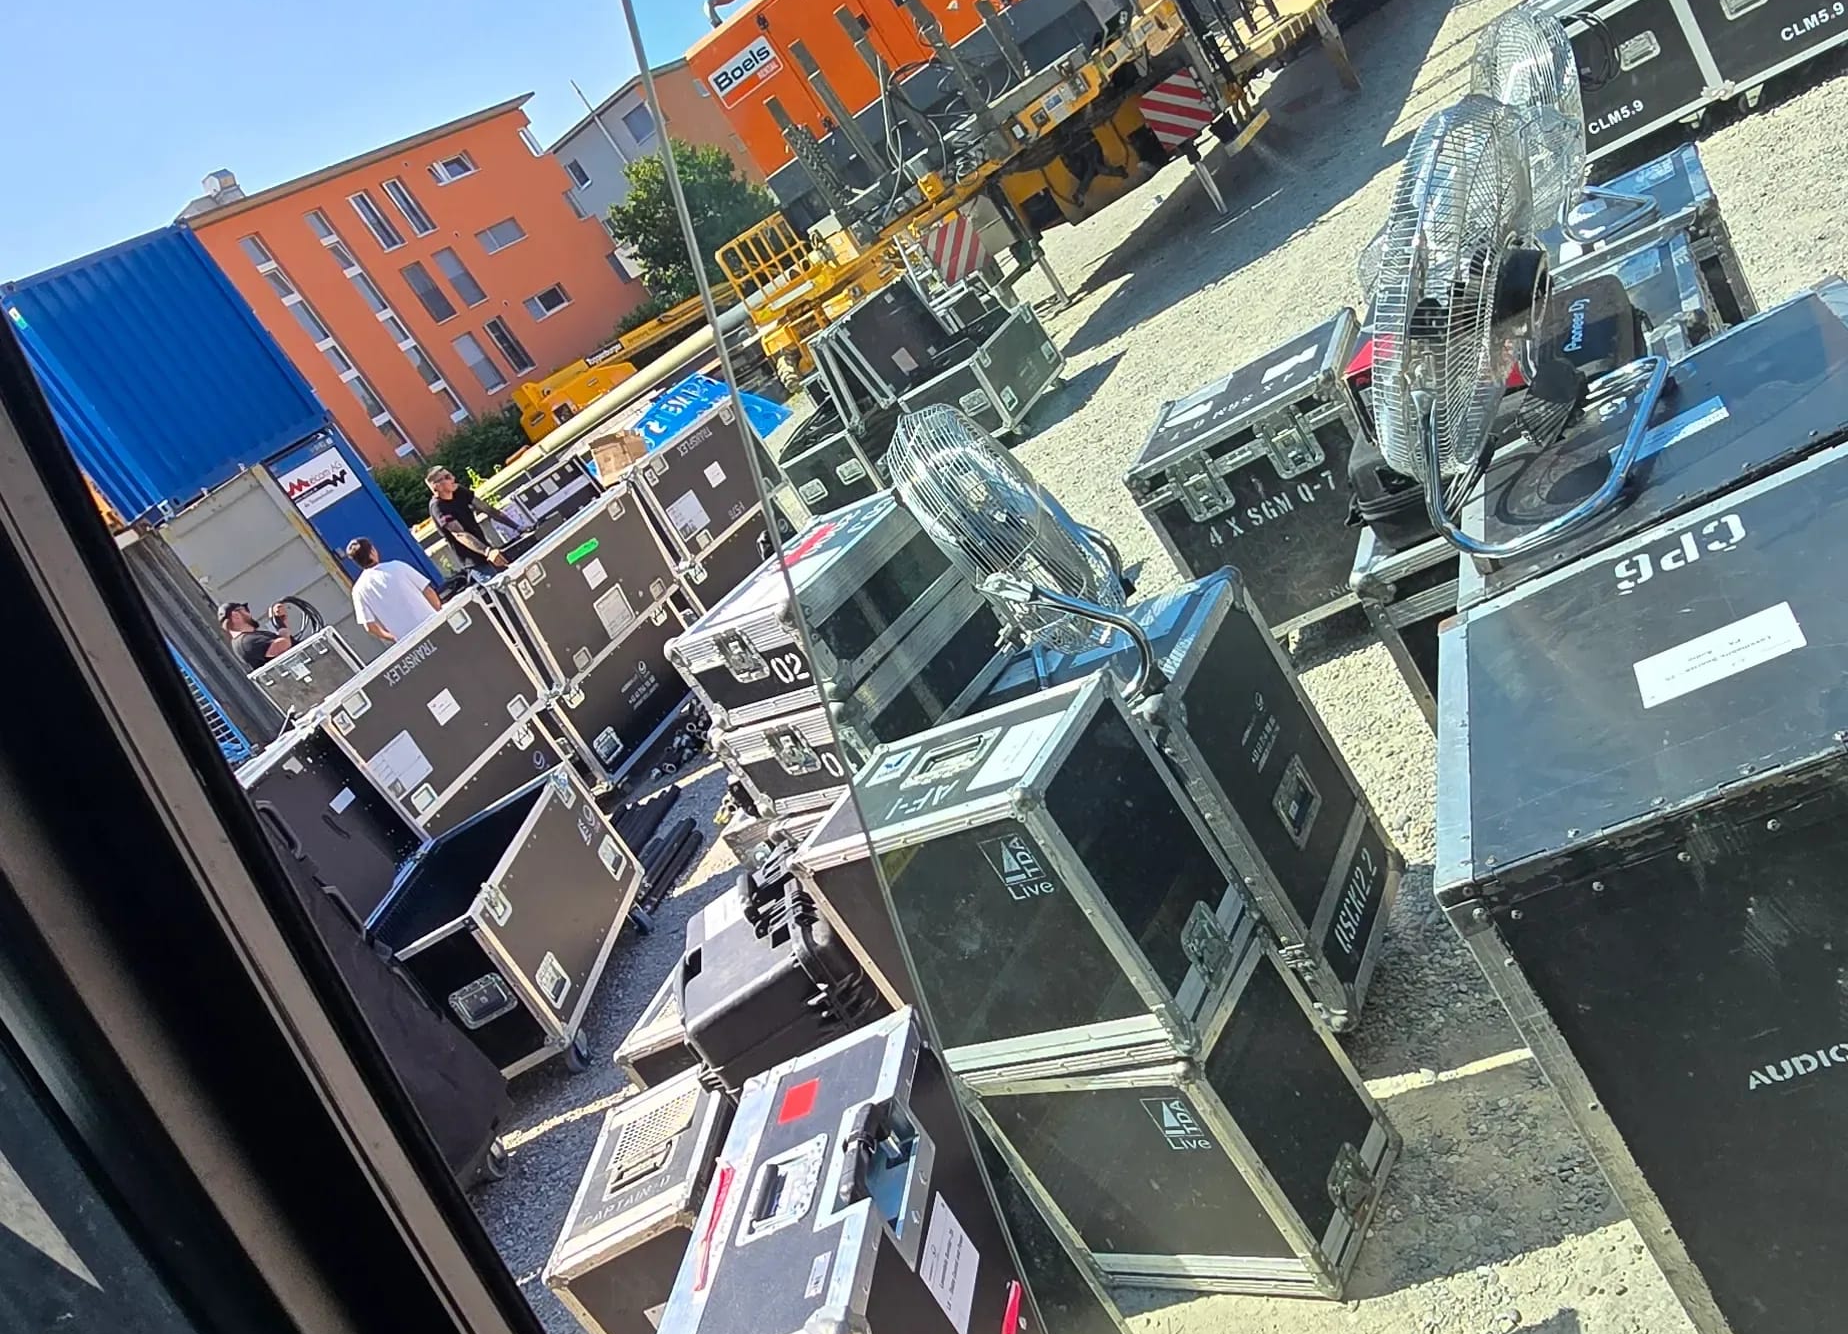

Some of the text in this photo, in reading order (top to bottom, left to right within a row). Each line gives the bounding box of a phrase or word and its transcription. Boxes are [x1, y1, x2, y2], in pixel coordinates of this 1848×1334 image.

[1780, 1, 1845, 42] CLM5.9
[713, 45, 770, 92] Boels
[1587, 100, 1644, 135] CLM5.9
[1563, 311, 1585, 352] Pioneer
[677, 426, 713, 458] TRANSFLEX
[1208, 470, 1337, 547] 4 X SGM Q-7
[1614, 513, 1747, 596] CP6
[383, 638, 438, 687] TRANSFLEX
[770, 652, 810, 684] 02
[885, 779, 960, 821] AF-1
[1007, 881, 1054, 900] Live
[1749, 1043, 1848, 1090] AUDIO
[1167, 1137, 1212, 1150] Live
[584, 1184, 651, 1225] CAPTAIN
